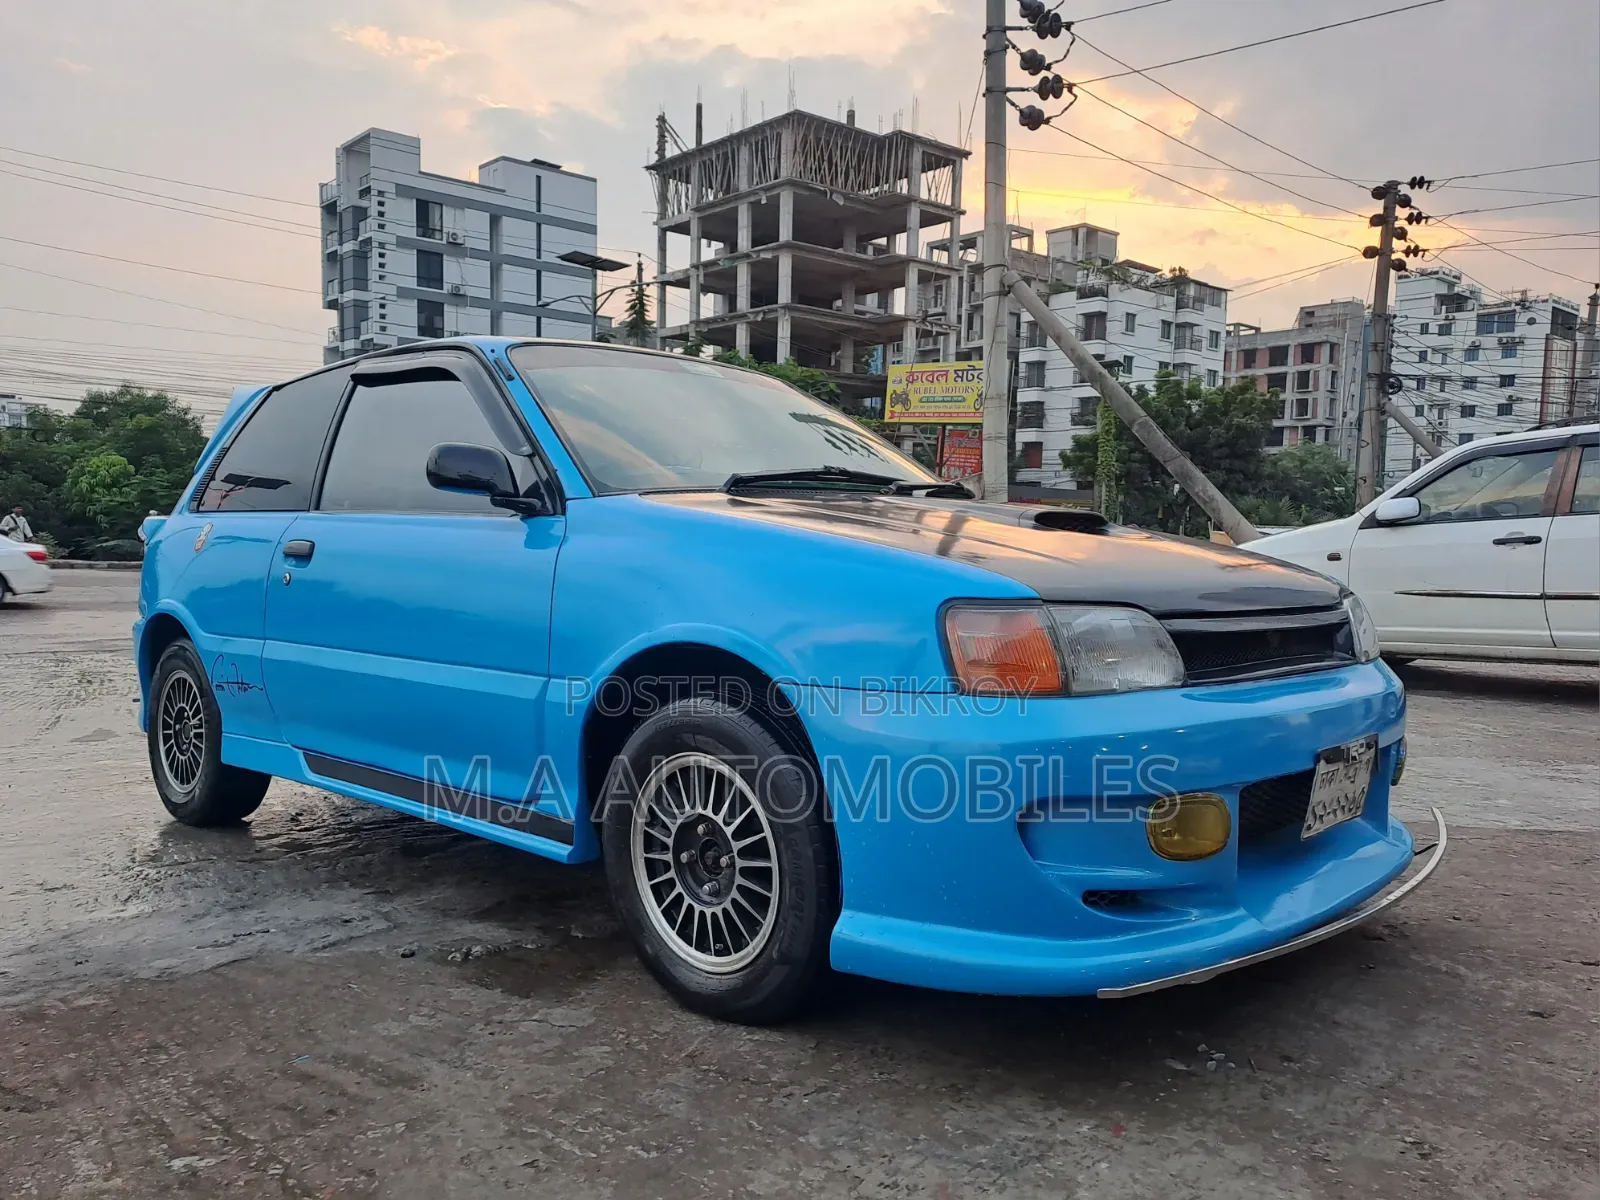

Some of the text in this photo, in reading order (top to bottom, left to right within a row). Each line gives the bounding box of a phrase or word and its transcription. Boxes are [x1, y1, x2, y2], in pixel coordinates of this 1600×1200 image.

[905, 369, 949, 384] রুবেল
[913, 385, 975, 395] RUBEL MOTORS
